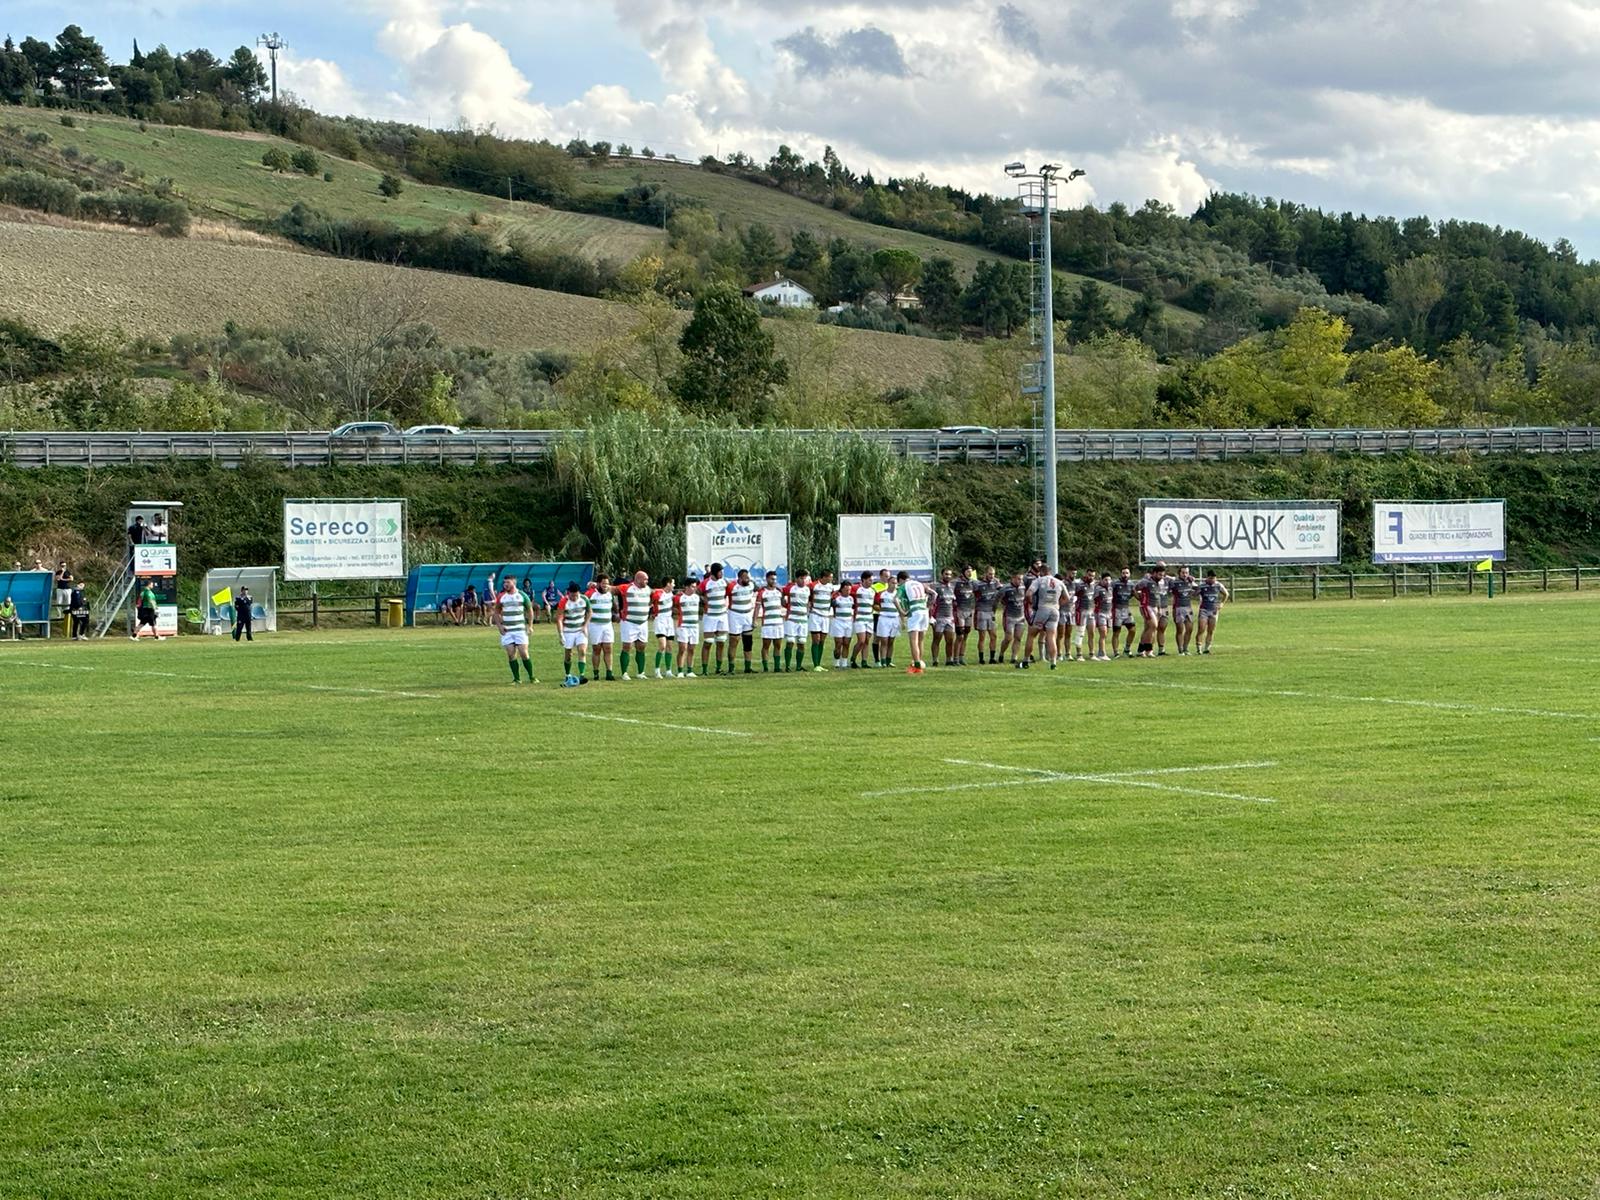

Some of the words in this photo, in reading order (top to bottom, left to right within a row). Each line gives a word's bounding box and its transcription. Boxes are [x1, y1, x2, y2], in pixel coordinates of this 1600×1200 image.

[290, 517, 369, 536] Sereco
[1187, 513, 1286, 551] QUARK
[912, 586, 923, 599] 11
